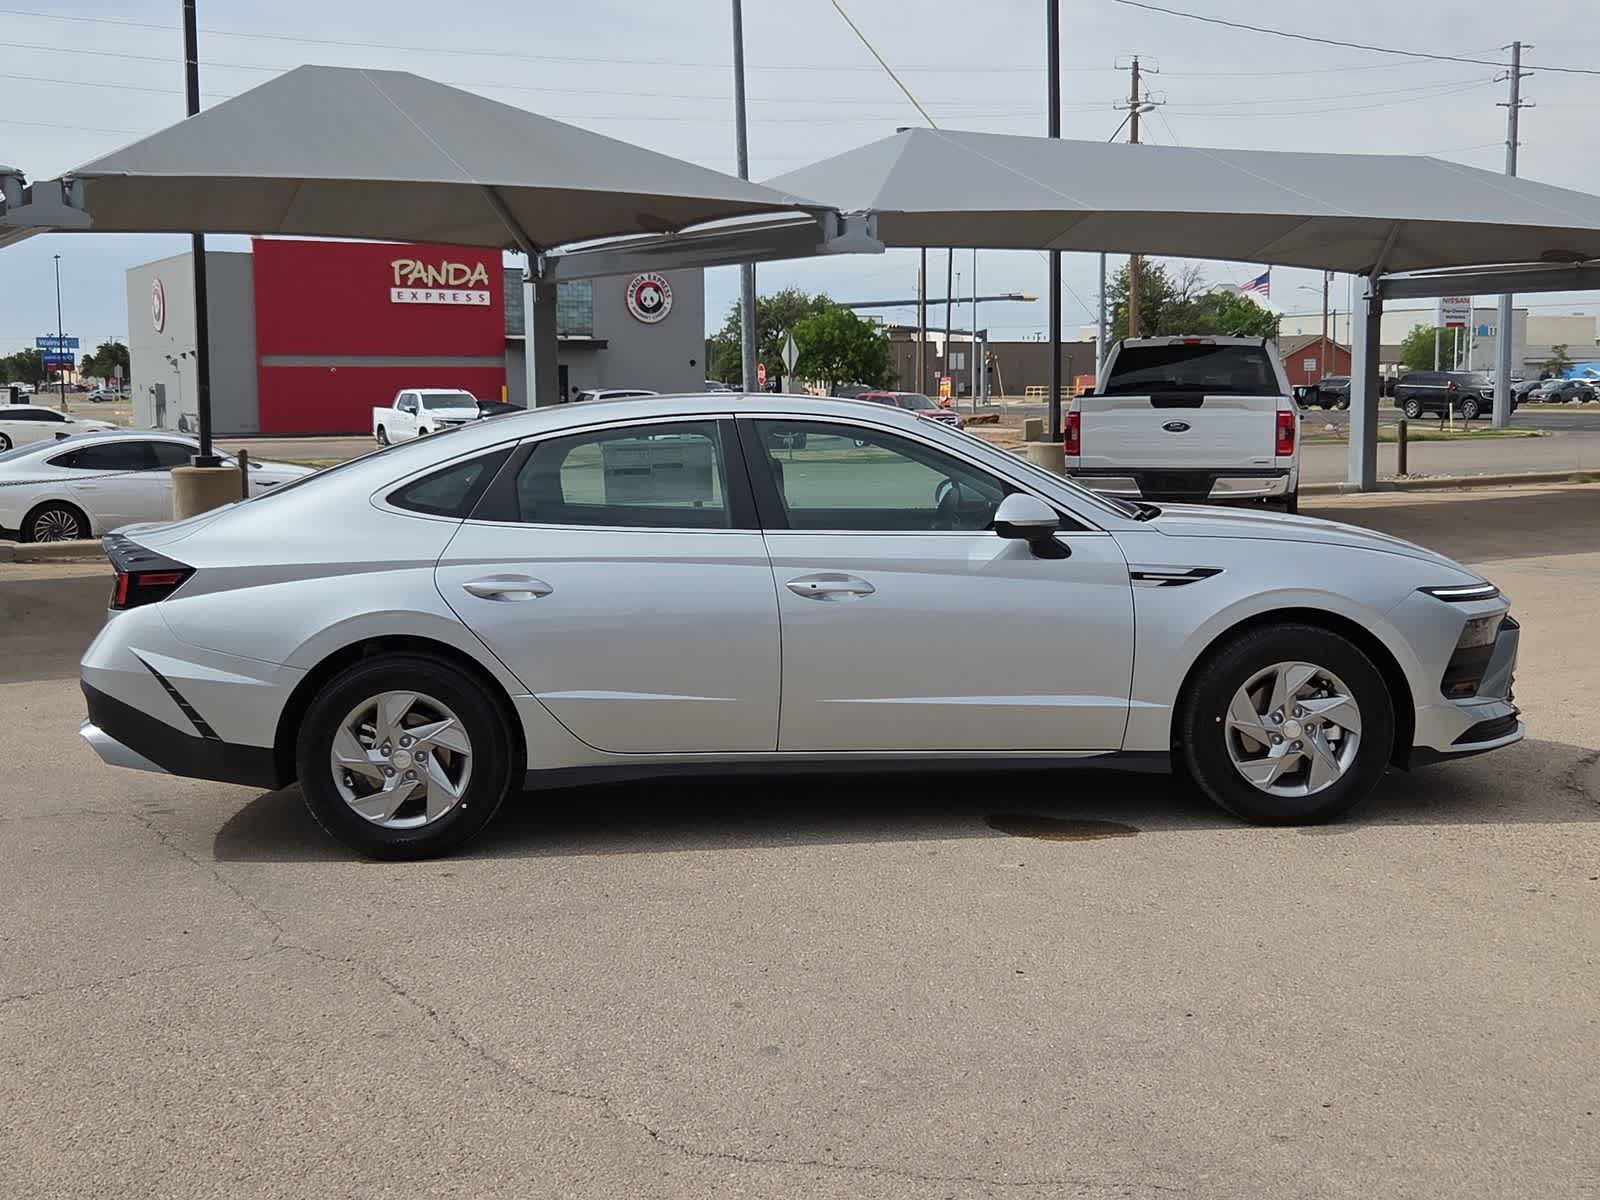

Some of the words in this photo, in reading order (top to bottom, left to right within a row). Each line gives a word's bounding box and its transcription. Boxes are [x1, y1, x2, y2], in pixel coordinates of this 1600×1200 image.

[391, 259, 489, 287] PANDA
[397, 291, 485, 302] EXPRESS
[628, 275, 646, 298] PANDA
[647, 274, 671, 298] EXPRESS
